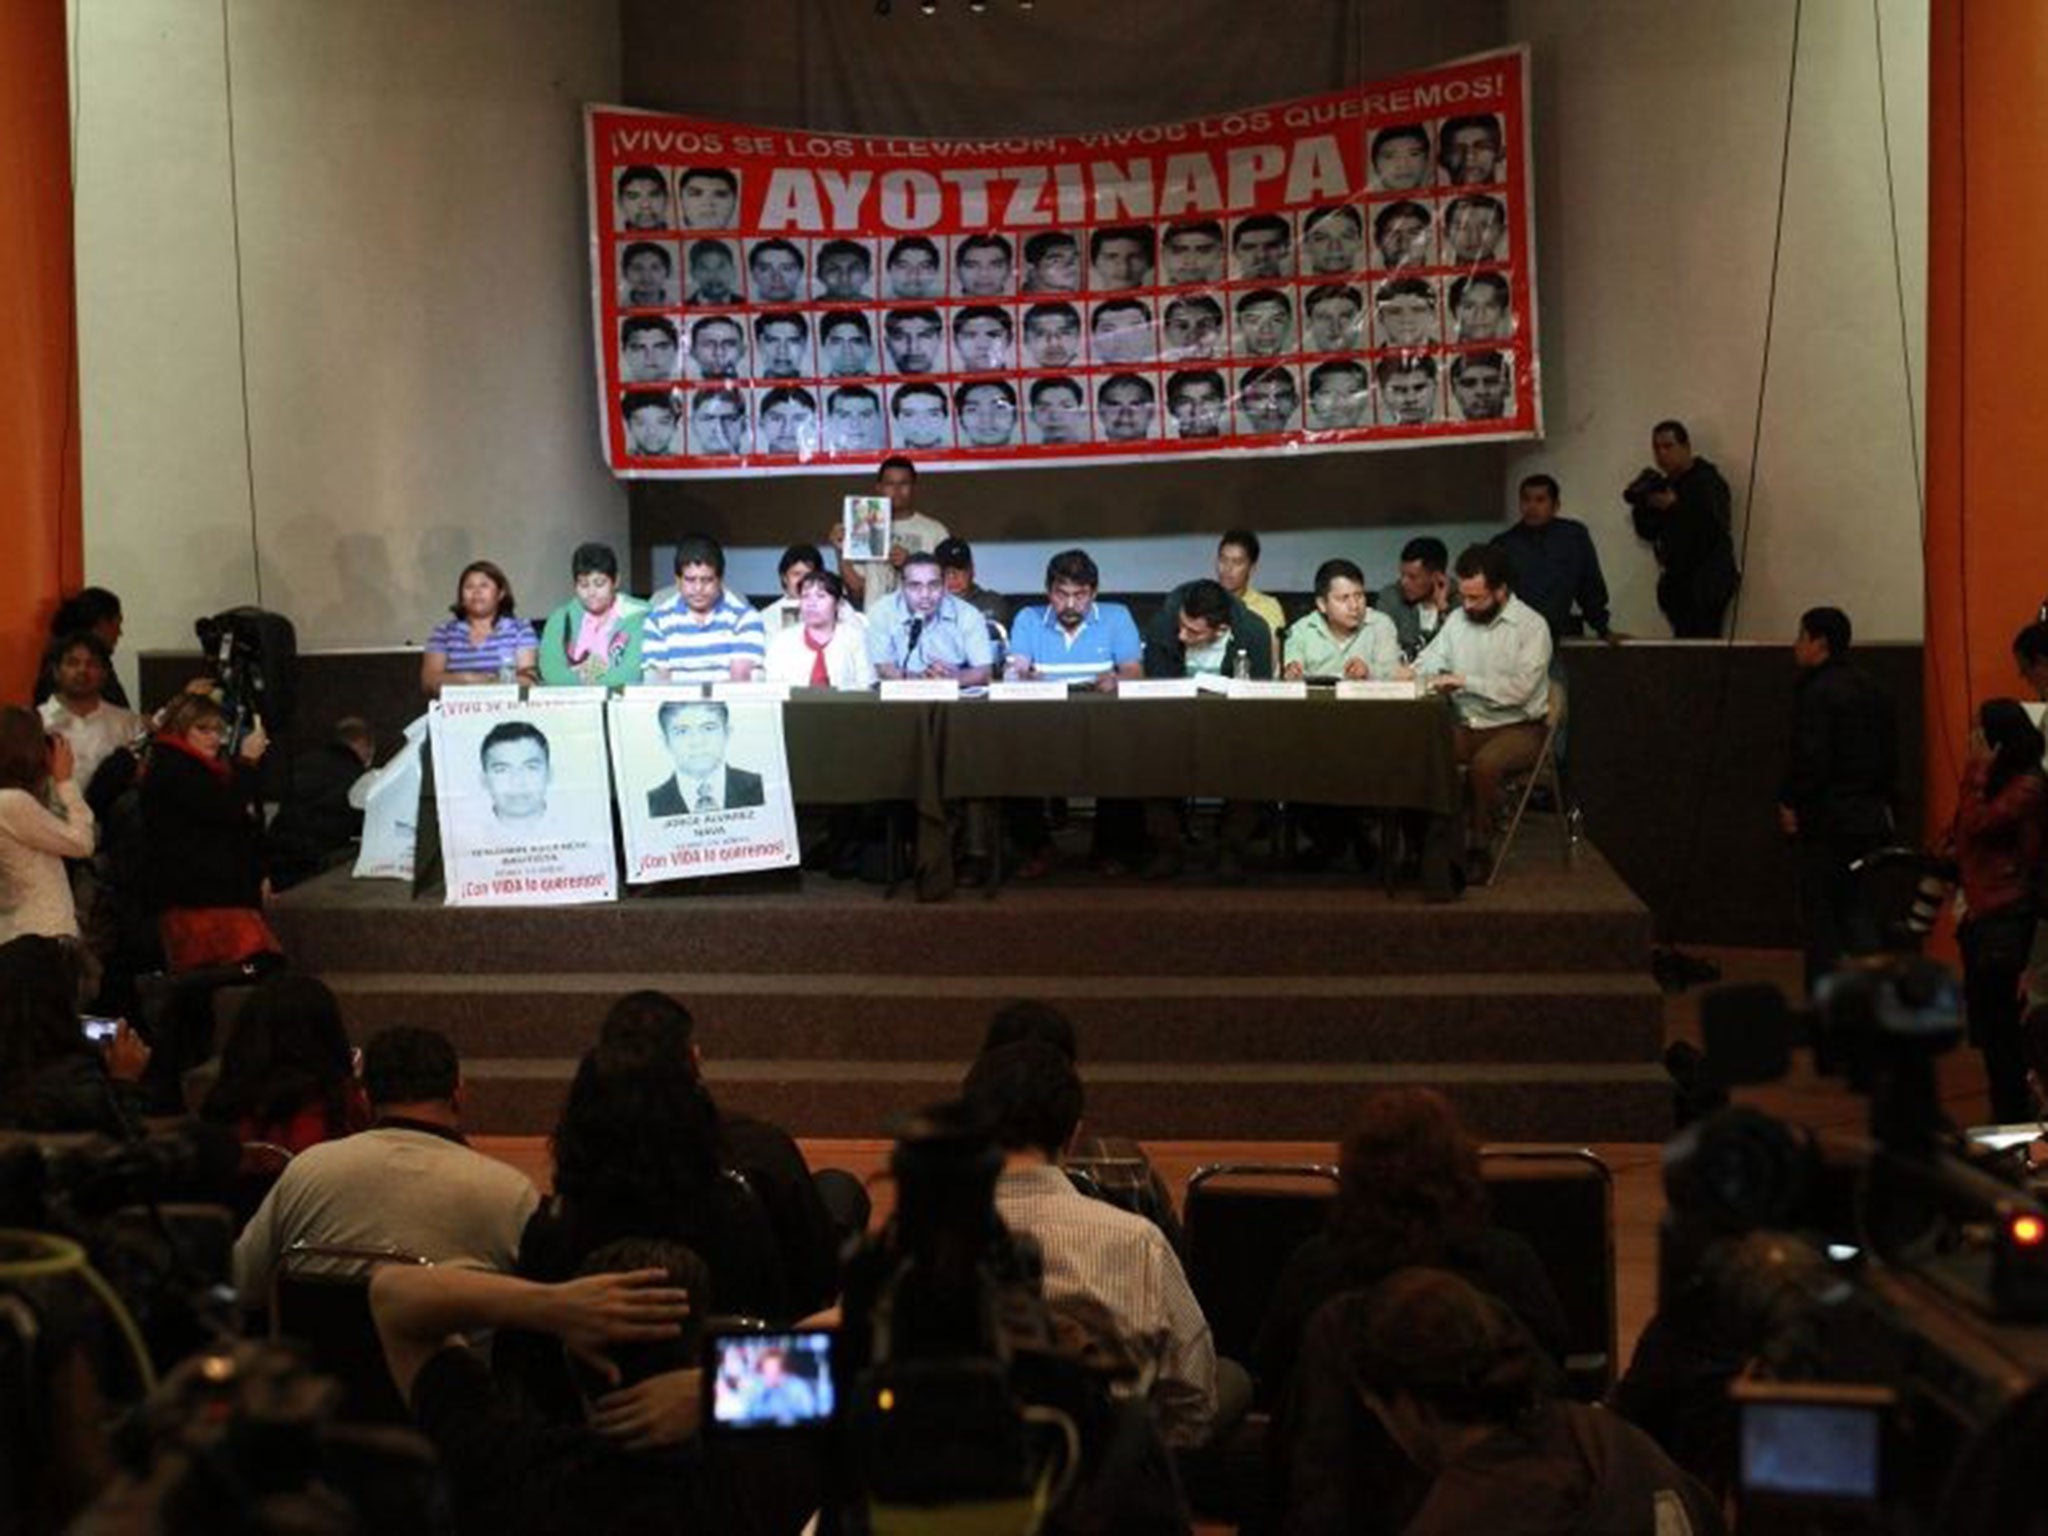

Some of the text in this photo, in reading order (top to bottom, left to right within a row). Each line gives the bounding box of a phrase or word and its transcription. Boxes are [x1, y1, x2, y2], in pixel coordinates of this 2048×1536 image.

[611, 129, 723, 156] ¡VIVOS
[733, 135, 778, 157] SE
[787, 137, 855, 158] LOS
[1200, 110, 1273, 136] LOS
[1284, 73, 1504, 129] QUEREMOS!
[757, 135, 1350, 231] AYOTZINAPA
[671, 850, 701, 866] VIDA
[492, 878, 523, 894] VIDA
